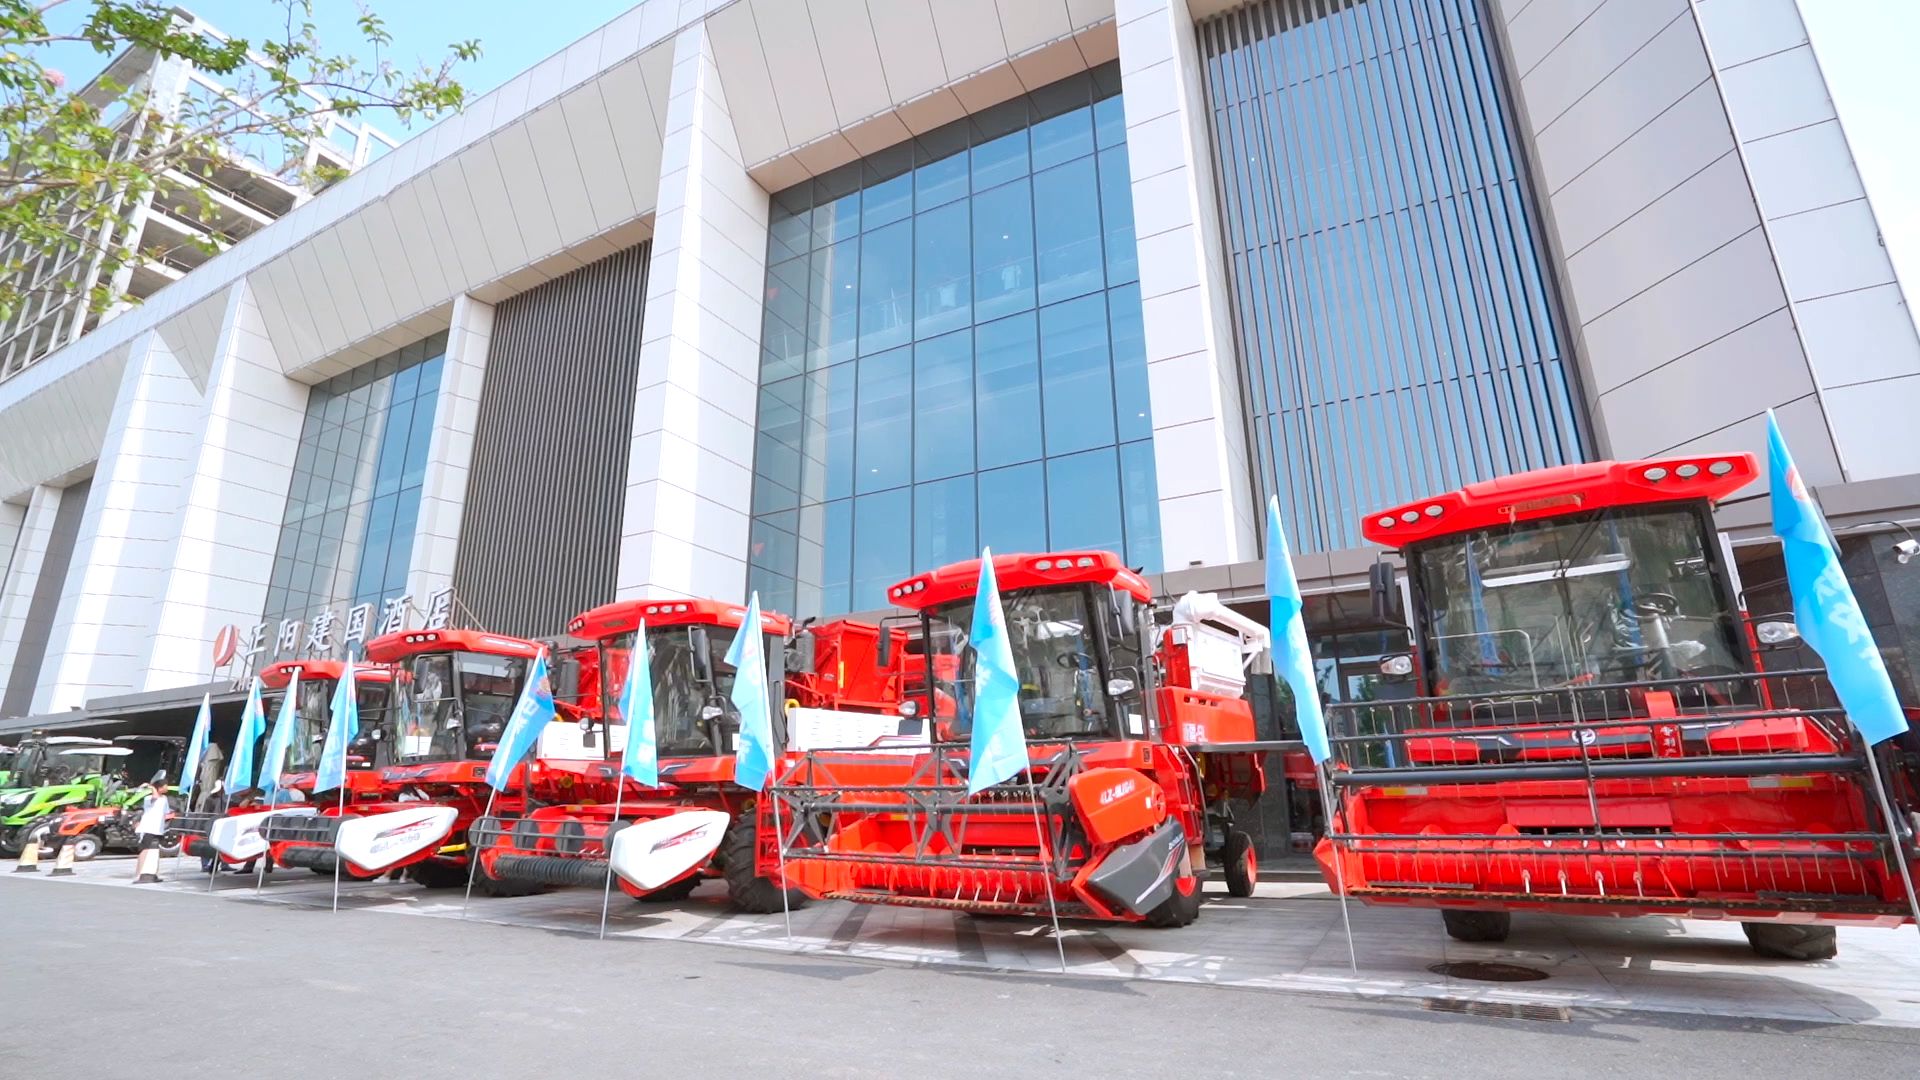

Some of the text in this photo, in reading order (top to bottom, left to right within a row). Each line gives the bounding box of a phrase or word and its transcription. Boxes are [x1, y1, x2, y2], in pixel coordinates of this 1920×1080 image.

[246, 585, 455, 657] 正阳建国酒店
